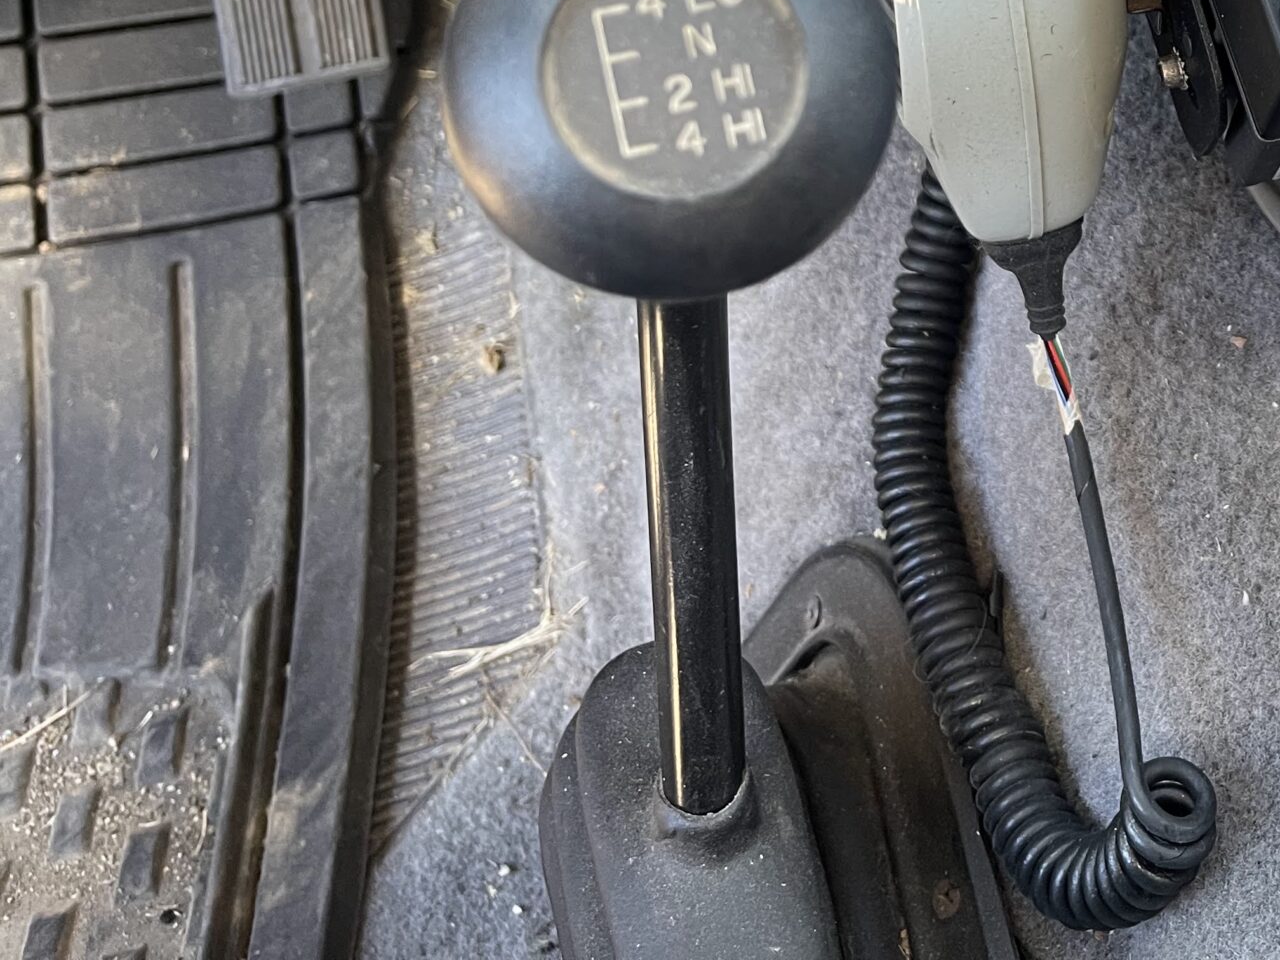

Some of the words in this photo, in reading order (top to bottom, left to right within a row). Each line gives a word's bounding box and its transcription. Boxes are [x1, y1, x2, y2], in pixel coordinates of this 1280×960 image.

[682, 22, 717, 59] N
[663, 73, 698, 115] 2
[710, 62, 756, 104] HI
[676, 120, 707, 157] 4
[722, 106, 767, 151] HI
